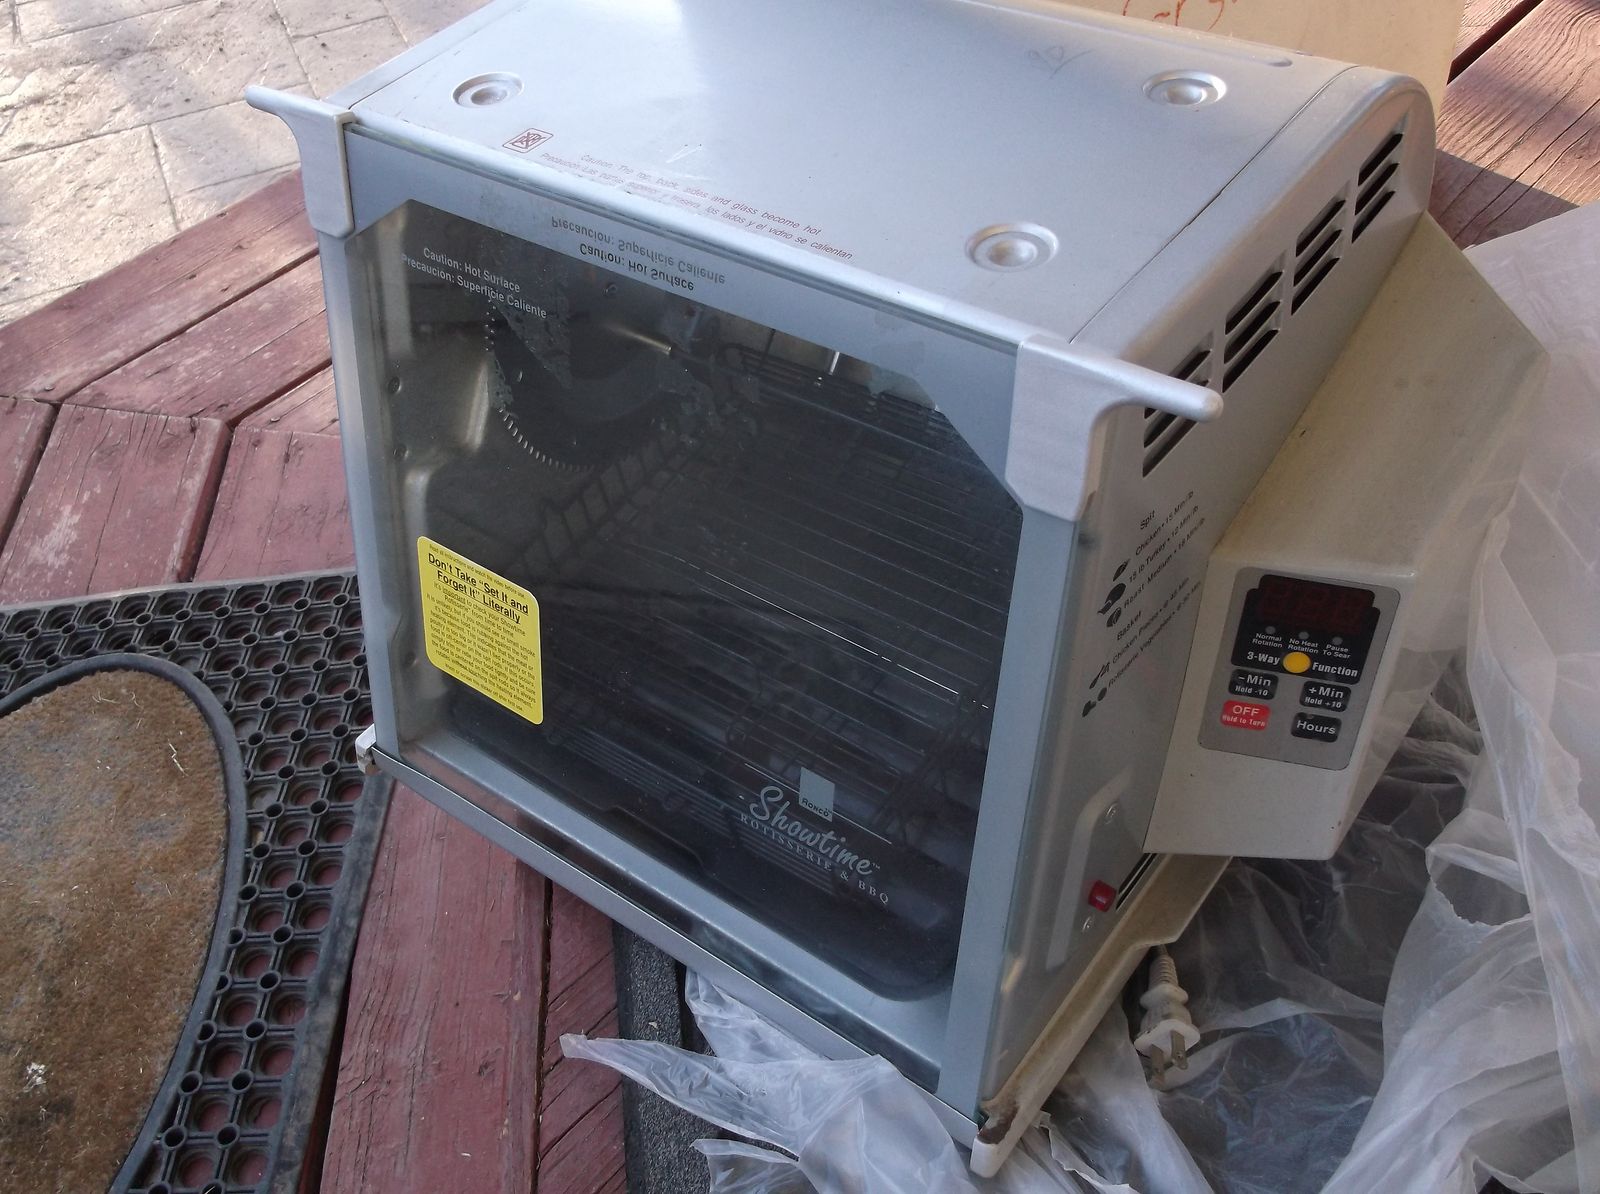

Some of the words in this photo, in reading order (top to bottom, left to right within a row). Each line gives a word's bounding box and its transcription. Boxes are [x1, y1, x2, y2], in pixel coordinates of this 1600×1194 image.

[732, 202, 758, 215] glass
[761, 211, 800, 228] become
[803, 225, 822, 236] hot
[721, 211, 745, 224] lados
[745, 220, 752, 228] y
[756, 223, 765, 231] el
[795, 236, 807, 245] se
[811, 241, 853, 260] calientan
[423, 247, 462, 271] Caution:
[464, 262, 481, 279] Hot
[483, 269, 520, 293] Surface
[456, 275, 504, 303] Superficie
[507, 293, 547, 319] Caliente
[1140, 510, 1155, 530] Spit
[1135, 526, 1162, 556] Chicken
[1146, 542, 1167, 565] Turkey
[428, 552, 452, 573] Don't
[454, 566, 476, 586] Take
[501, 591, 507, 603] It
[510, 596, 528, 614] and
[437, 569, 467, 596] Forget
[482, 594, 520, 625] Literally
[1124, 583, 1145, 608] Roast
[1117, 610, 1141, 641] Basket
[1252, 638, 1283, 648] Rotation
[1255, 632, 1282, 642] Normal
[1289, 638, 1300, 646] No
[1301, 640, 1319, 648] Heat
[1326, 643, 1349, 652] Pause
[1288, 644, 1319, 654] Rotation
[1323, 649, 1332, 657] To
[1333, 651, 1351, 659] Sear
[1246, 651, 1280, 665] 3-Way
[1312, 661, 1358, 678] Function
[1234, 684, 1253, 694] Hold
[1254, 686, 1268, 697] -10
[1232, 705, 1260, 716] OFF
[1304, 696, 1322, 705] Hold
[1324, 698, 1342, 709] +10
[1222, 714, 1238, 723] Hold
[1249, 718, 1265, 727] Turn
[1297, 719, 1336, 735] Hours
[739, 813, 832, 872] ROTISSERIE
[840, 870, 849, 881] &
[858, 880, 889, 905] BBQ
